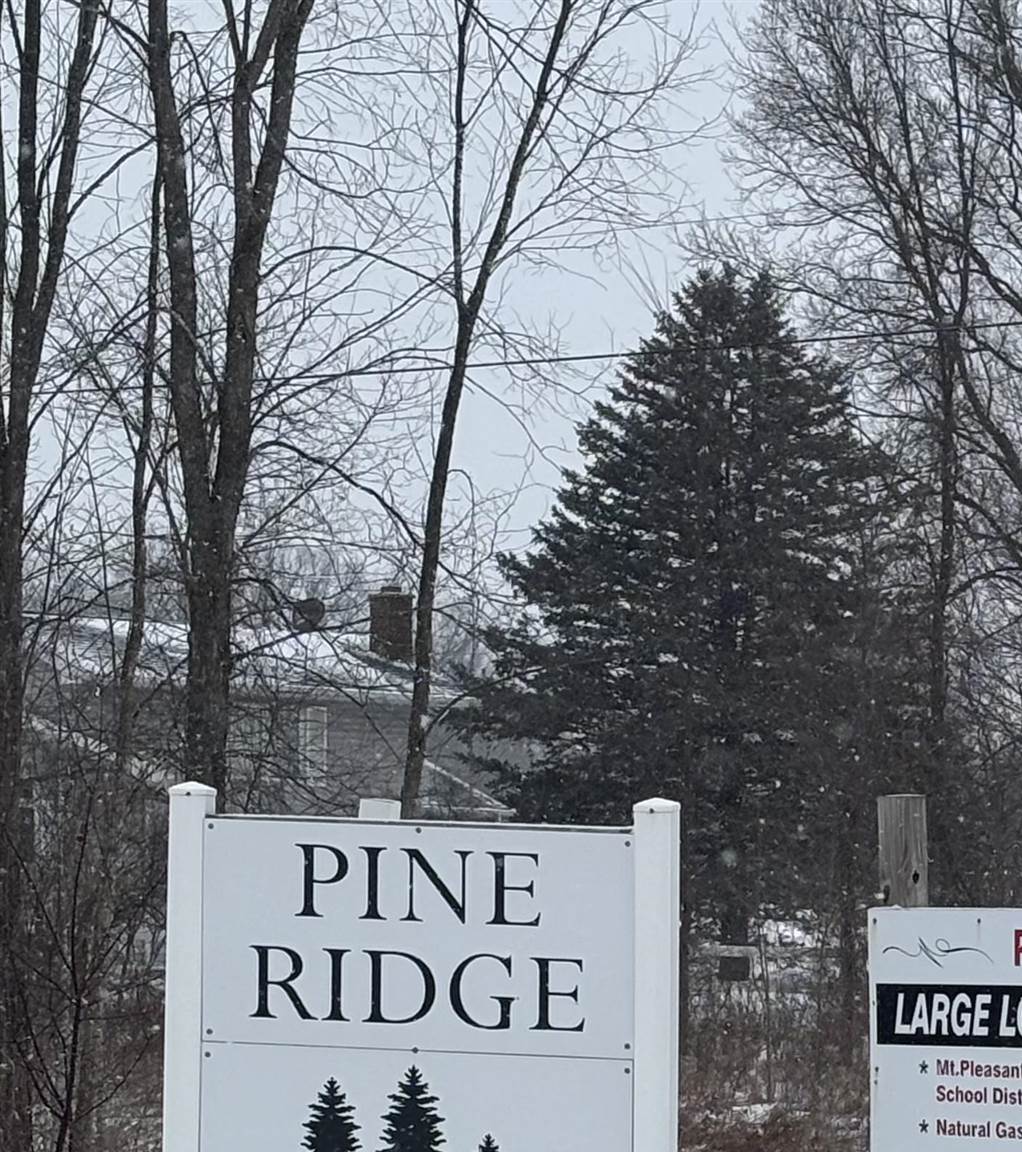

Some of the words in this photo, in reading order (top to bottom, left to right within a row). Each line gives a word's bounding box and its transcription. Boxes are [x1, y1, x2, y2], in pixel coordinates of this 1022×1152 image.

[294, 842, 542, 927] PINE
[248, 944, 585, 1032] RIDGE
[894, 992, 992, 1037] LARGE
[936, 1086, 988, 1104] School
[936, 1119, 990, 1138] Natural
